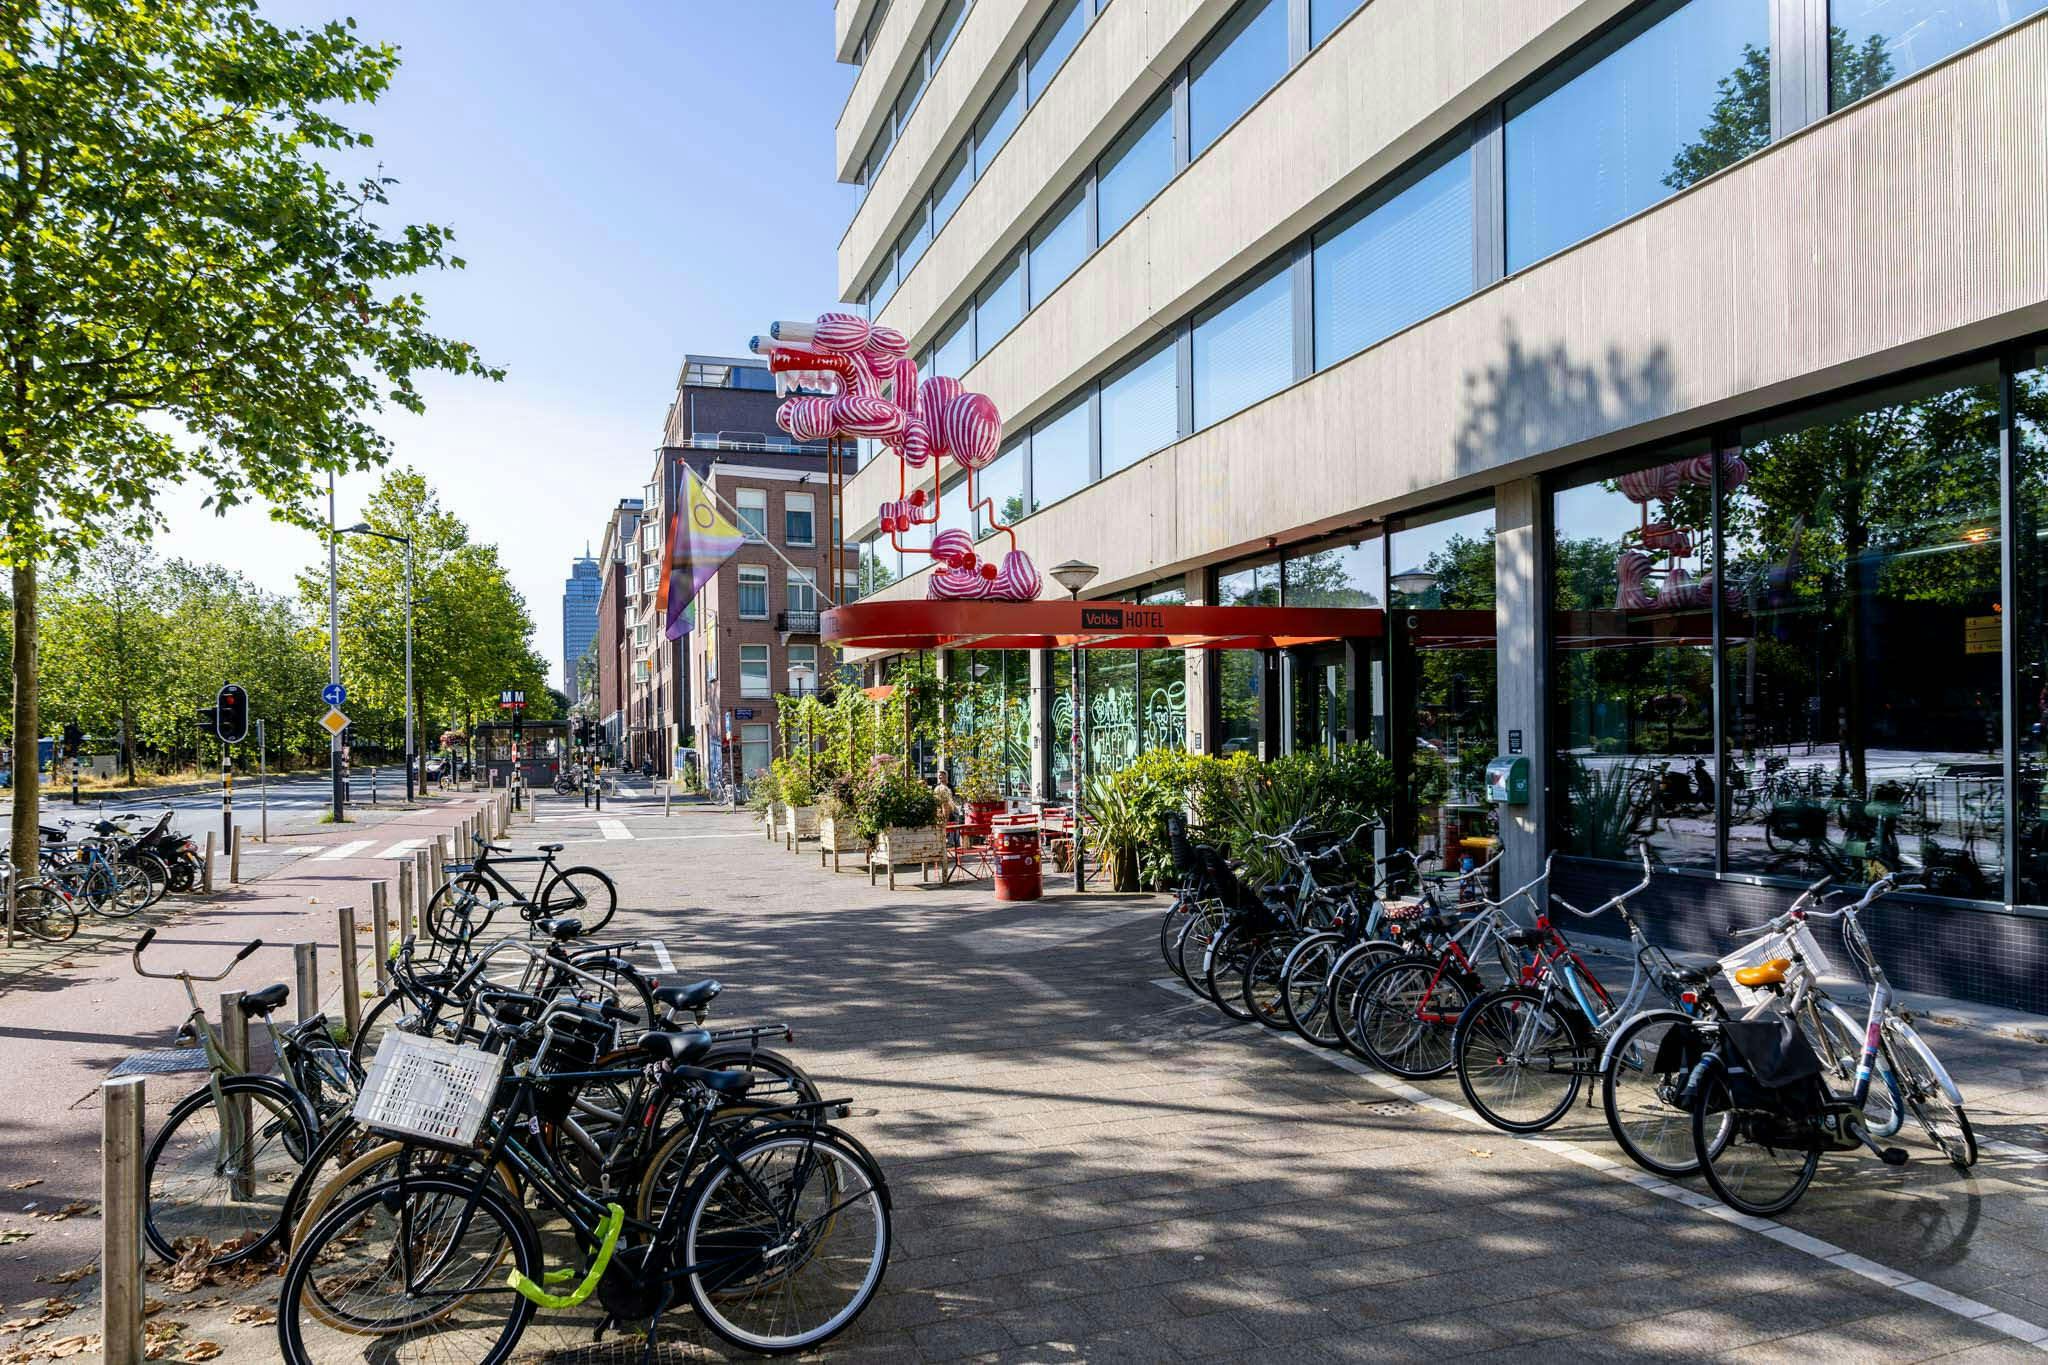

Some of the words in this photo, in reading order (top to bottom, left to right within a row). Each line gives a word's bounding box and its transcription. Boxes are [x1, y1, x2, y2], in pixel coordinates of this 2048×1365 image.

[1086, 612, 1119, 625] Volks
[1126, 611, 1164, 628] HOTEL
[502, 691, 511, 702] M
[514, 691, 524, 702] M
[1097, 730, 1127, 755] HAPPY
